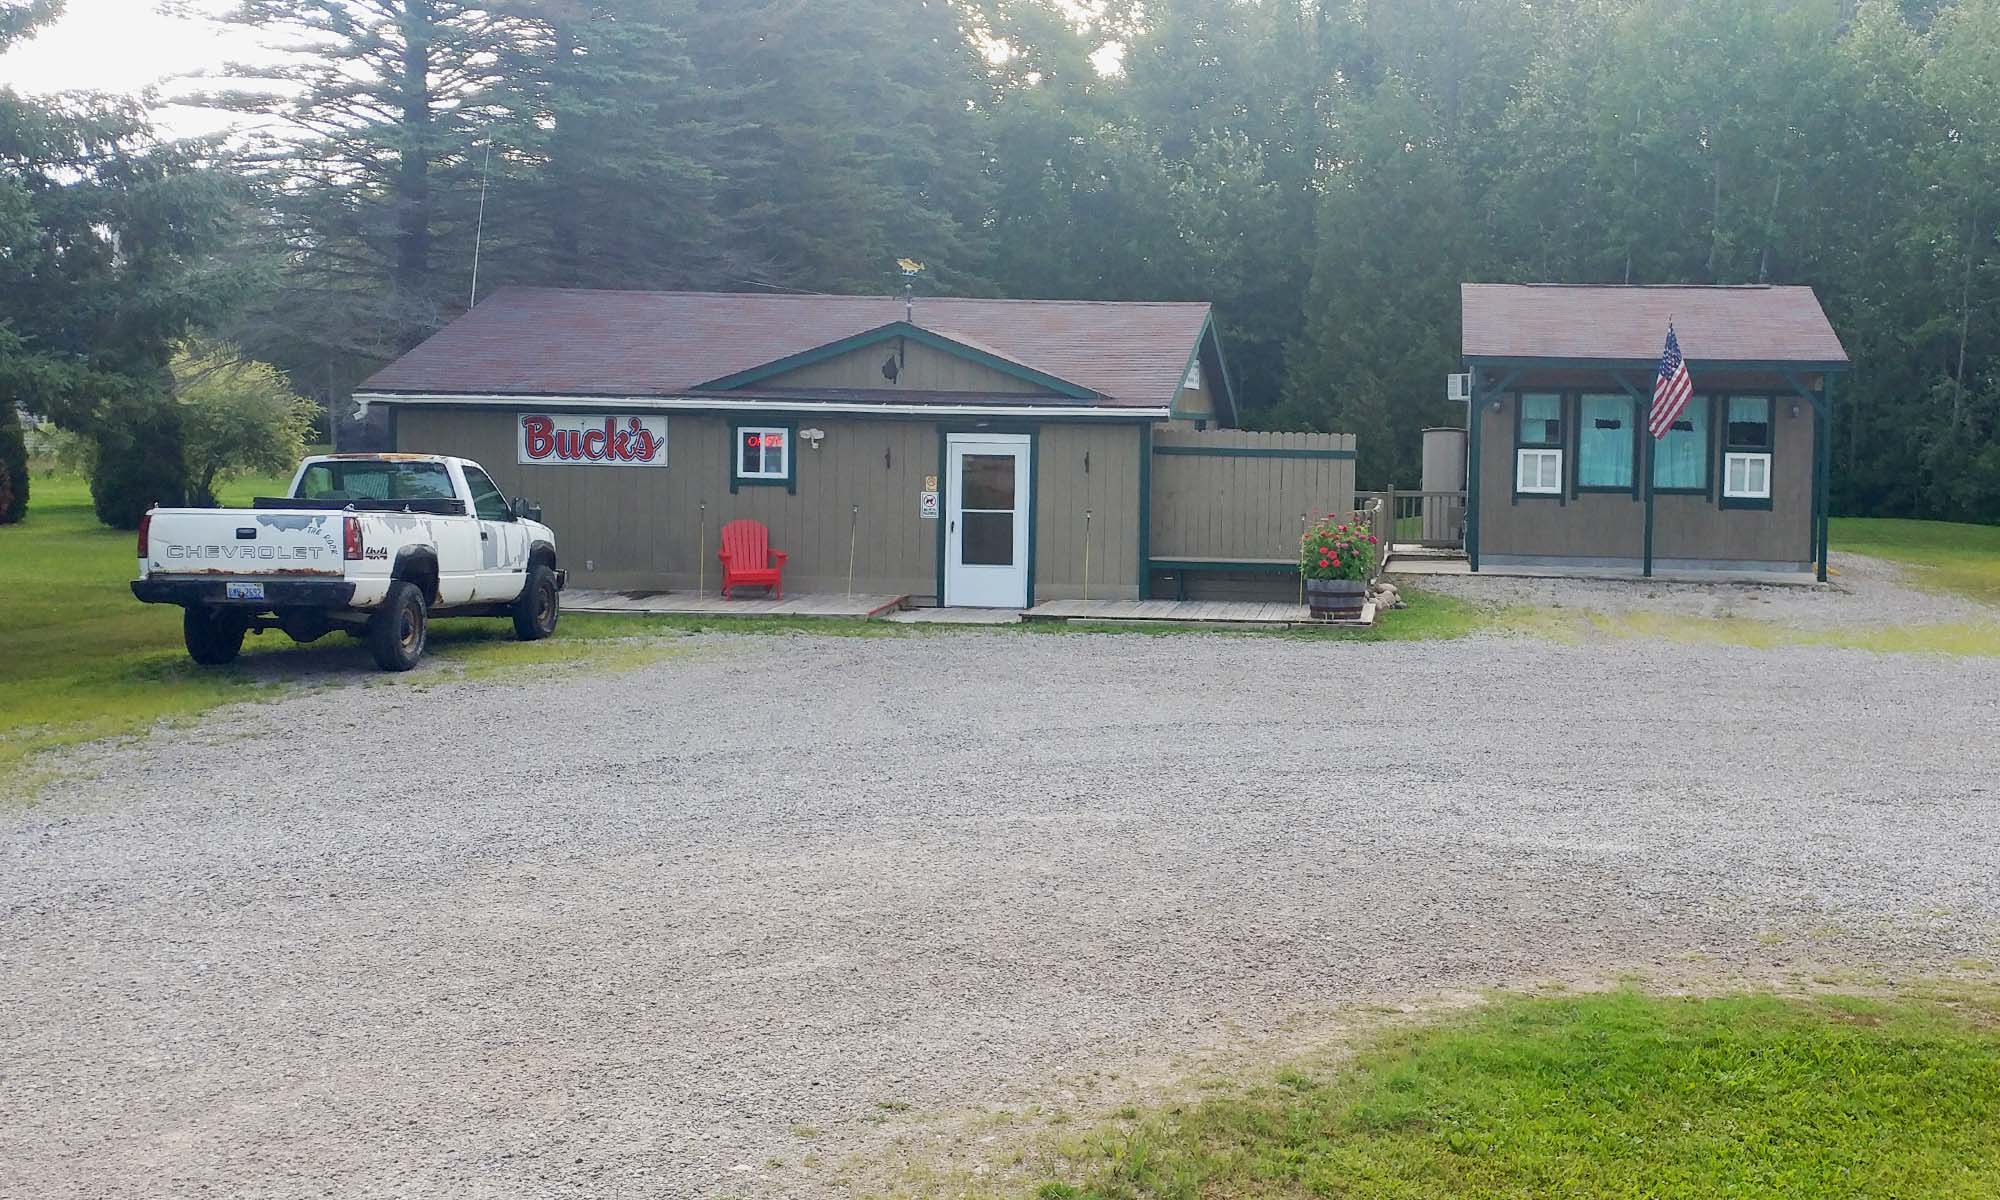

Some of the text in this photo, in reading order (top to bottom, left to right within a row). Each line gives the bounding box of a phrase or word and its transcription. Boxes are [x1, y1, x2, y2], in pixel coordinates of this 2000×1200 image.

[522, 415, 665, 461] Buck's
[307, 526, 322, 536] THE
[166, 545, 324, 560] CHEVROLET
